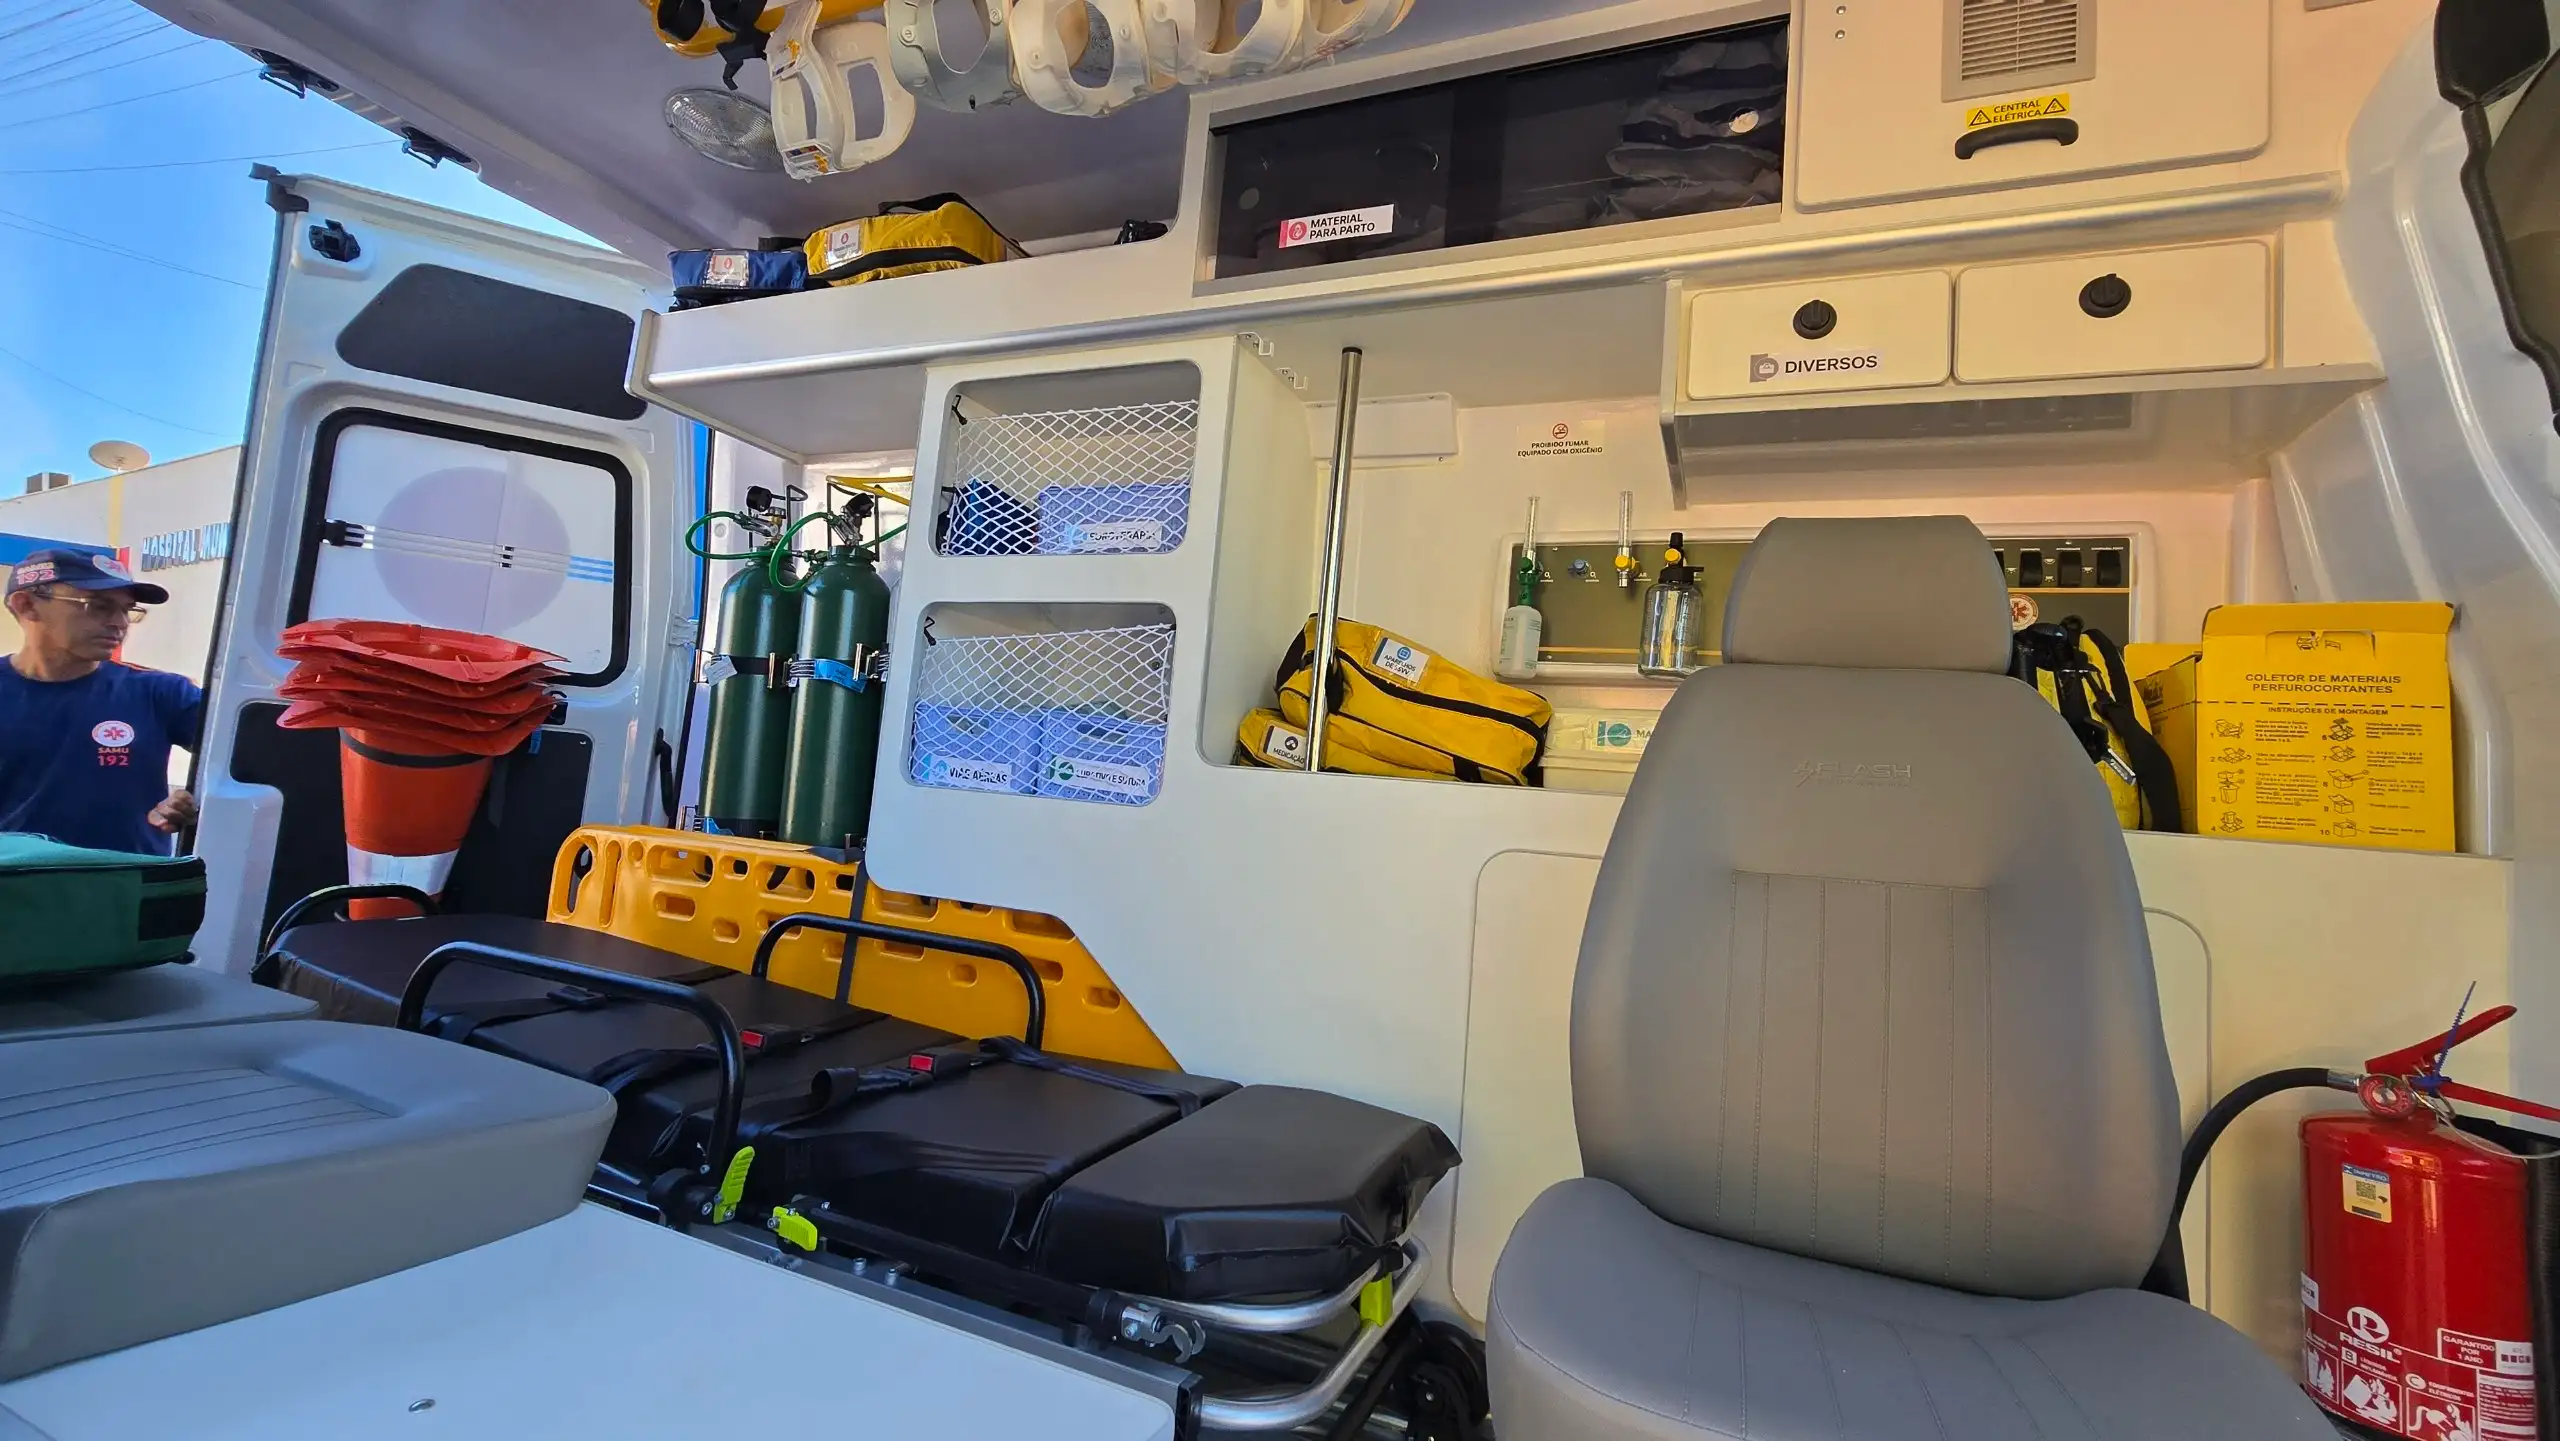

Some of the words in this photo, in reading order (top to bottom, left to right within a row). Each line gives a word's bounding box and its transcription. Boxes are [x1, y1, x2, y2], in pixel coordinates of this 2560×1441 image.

[1993, 99, 2041, 113] CENTRAL
[1993, 109, 2042, 123] ELÉTRICA
[1310, 213, 1363, 228] MATERIAL
[1309, 226, 1337, 239] PARA
[1339, 222, 1375, 235] PARTO
[1785, 355, 1877, 374] DIVERSOS
[1531, 441, 1564, 449] PROIBIDO
[1517, 448, 1551, 457] EQUIPADO
[1569, 446, 1603, 454] OXIGÊNIO
[142, 529, 196, 571] HOSPITAL
[200, 523, 231, 560] MUN
[16, 569, 55, 585] 192
[1384, 654, 1417, 672] APARELHOS
[1385, 661, 1394, 669] DE
[2245, 673, 2305, 683] COLETOR
[2309, 673, 2327, 683] DE
[2330, 674, 2402, 684] MATERIAIS
[2252, 683, 2393, 694] PERFUROCORTANTES
[2268, 705, 2322, 715] INSTRUÇÕES
[2338, 708, 2388, 716] MONTAGEM
[1636, 729, 1652, 738] MA
[98, 755, 129, 766] 192
[1273, 747, 1305, 764] MEDICAÇÃO
[1111, 774, 1117, 783] E
[2339, 1331, 2401, 1364] RESIL
[2443, 1335, 2495, 1352] GARANTIDO
[2460, 1347, 2479, 1356] POR
[2464, 1355, 2484, 1364] ANO
